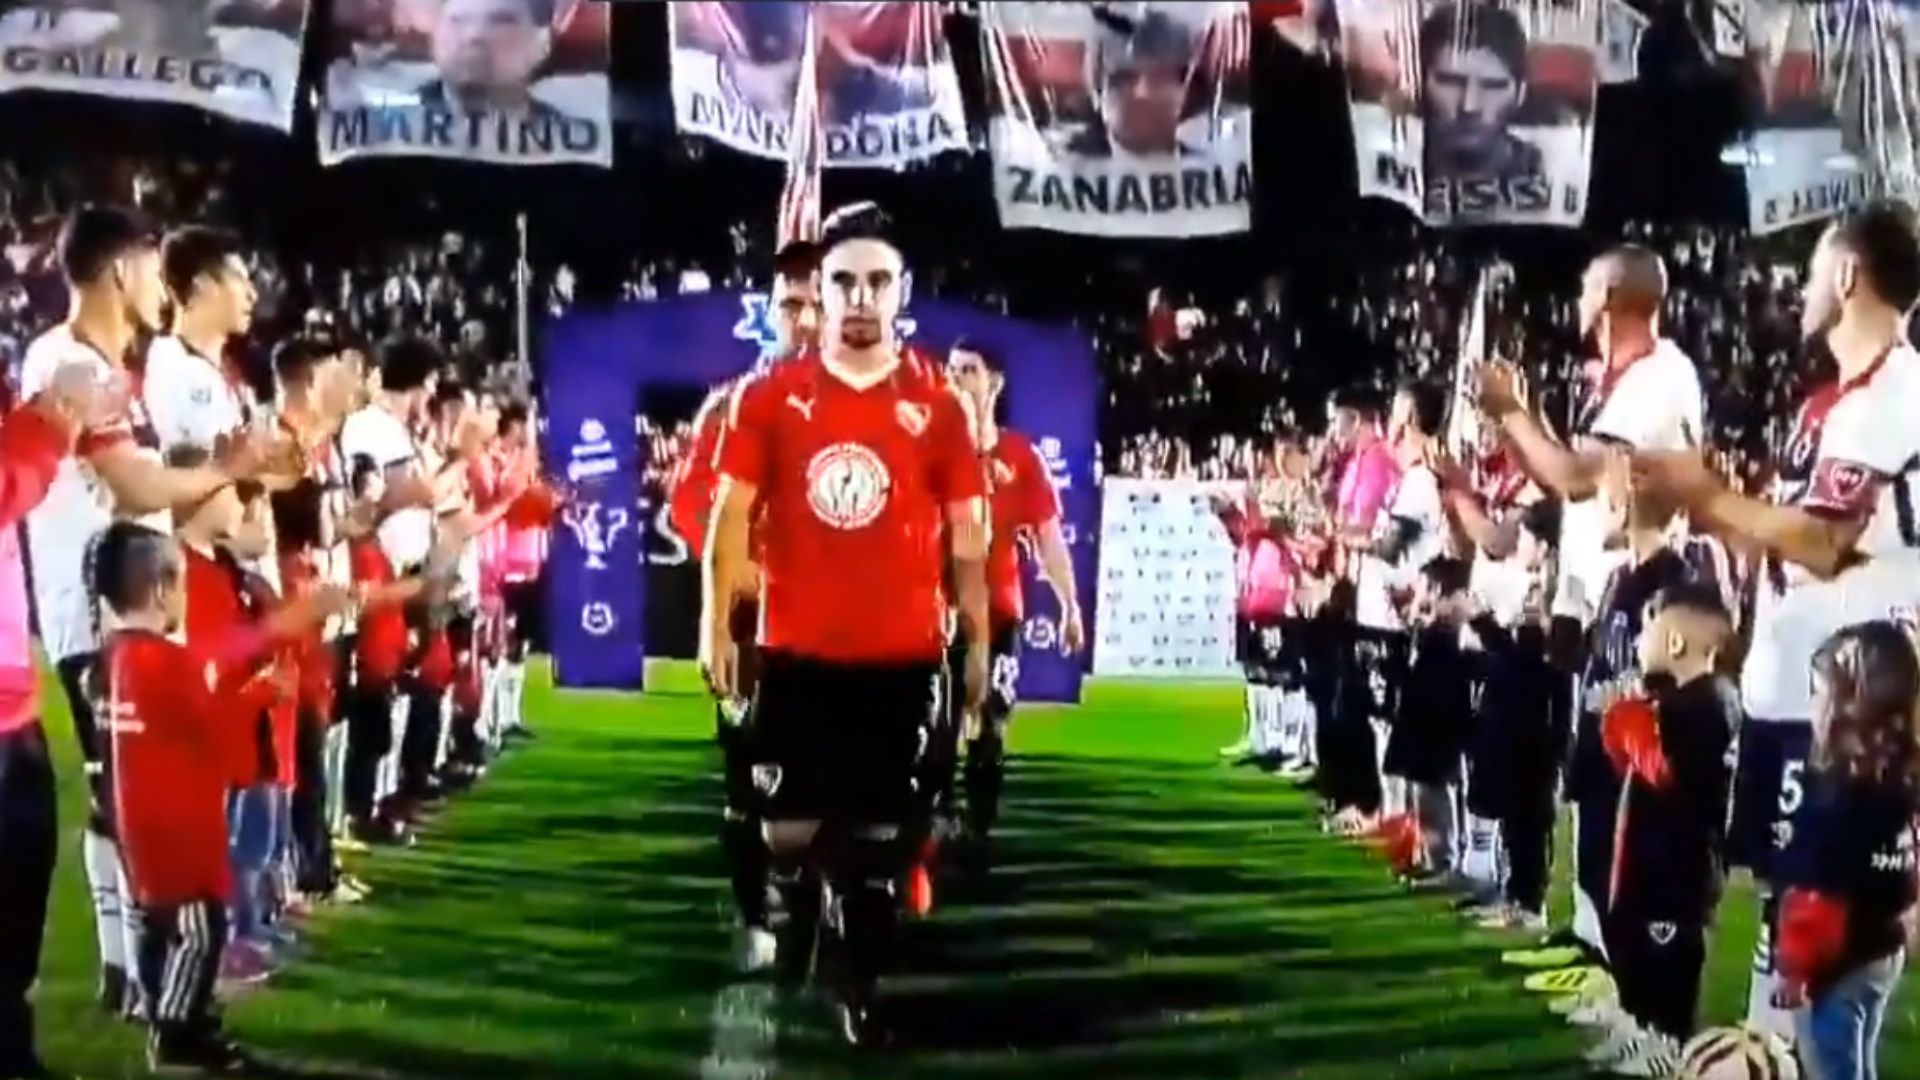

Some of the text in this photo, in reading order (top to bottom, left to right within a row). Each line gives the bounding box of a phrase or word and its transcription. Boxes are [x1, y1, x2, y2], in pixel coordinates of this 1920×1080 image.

[331, 104, 599, 154] MARTINO
[691, 92, 954, 159] MARDONA
[1007, 160, 1249, 215] ZANABRIA
[1778, 760, 1804, 815] 5
